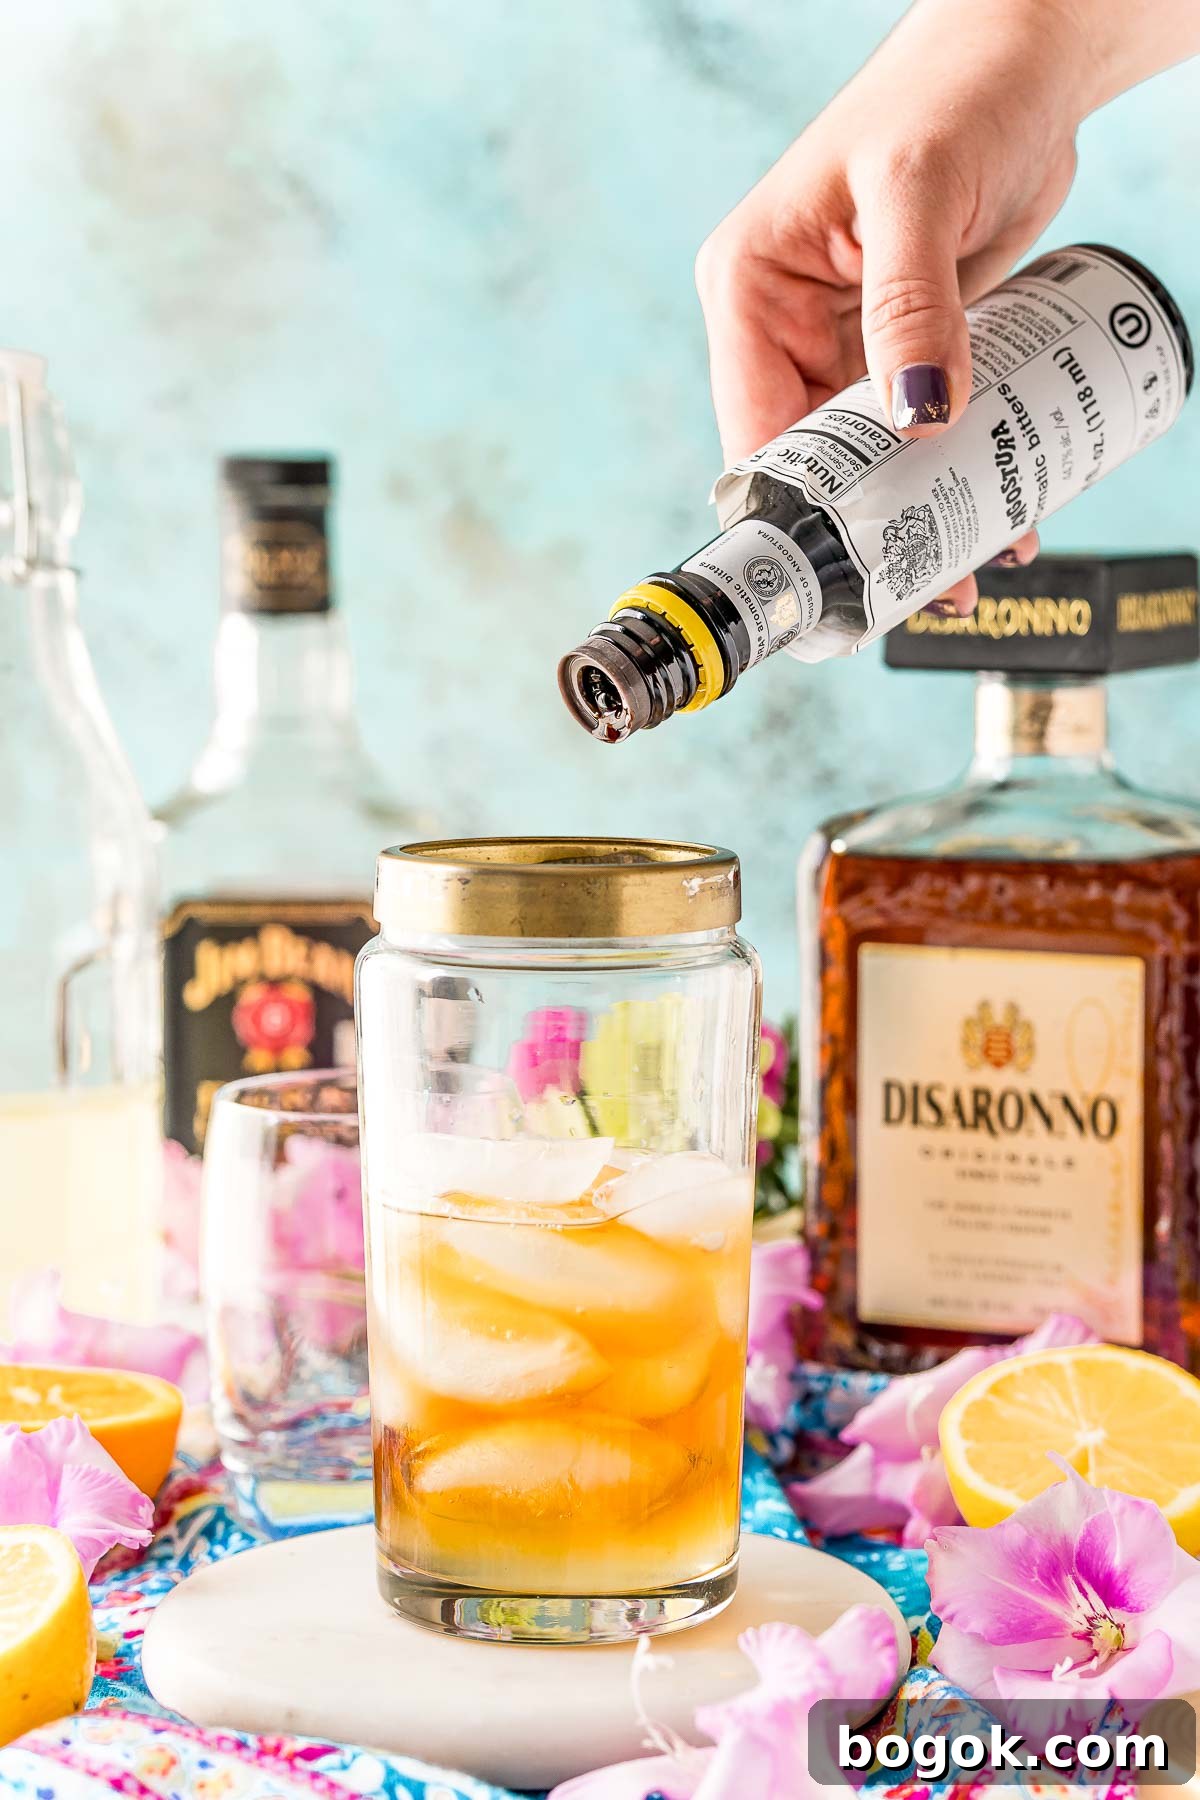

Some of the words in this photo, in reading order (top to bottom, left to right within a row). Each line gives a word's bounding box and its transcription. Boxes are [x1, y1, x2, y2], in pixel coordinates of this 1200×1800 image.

[1053, 345, 1087, 383] mL)
[997, 381, 1042, 451] bitters
[1074, 385, 1105, 432] (118
[827, 412, 892, 452] Calories
[851, 434, 881, 458] Amount
[826, 441, 863, 472] Serving
[990, 419, 1027, 530] ANGOSTURA
[698, 561, 733, 584] bitters
[757, 529, 802, 574] ANGOSTURA
[799, 574, 810, 590] OF
[733, 583, 764, 632] aromatic
[882, 1077, 1119, 1143] DISARONNO
